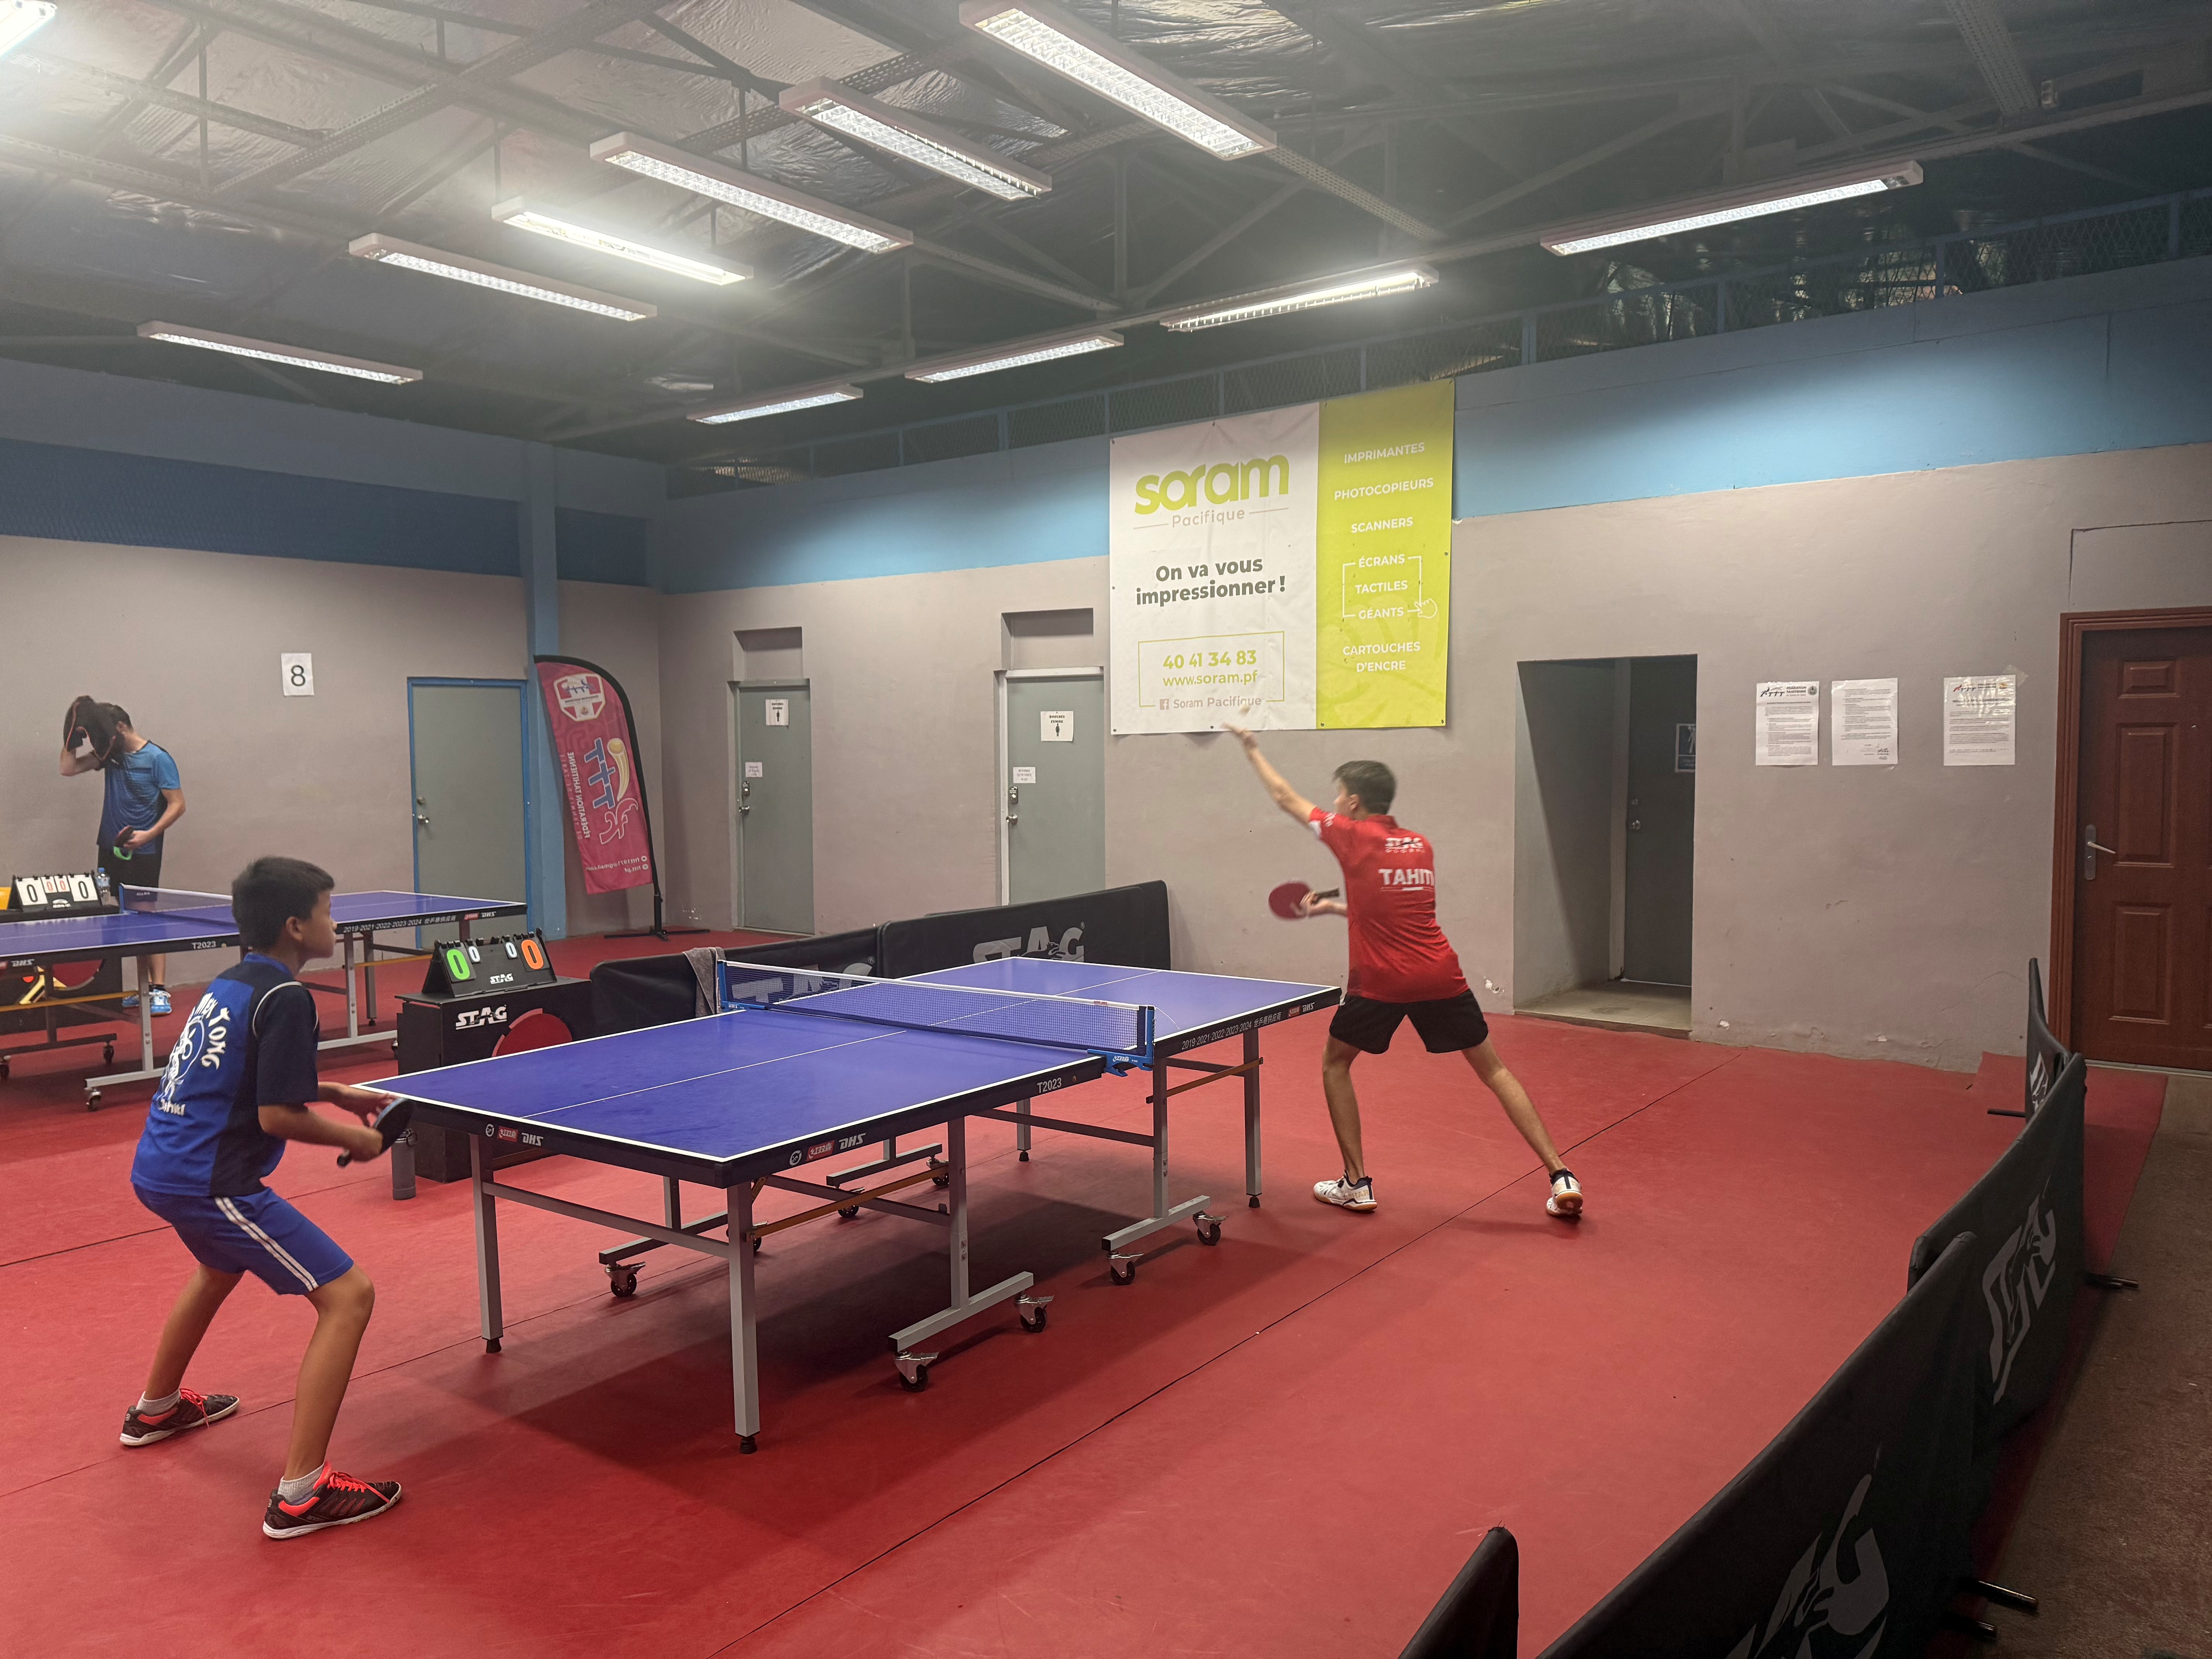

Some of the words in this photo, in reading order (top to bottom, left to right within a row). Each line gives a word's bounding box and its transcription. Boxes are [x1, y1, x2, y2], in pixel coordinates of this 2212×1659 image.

[1345, 442, 1424, 464] IMPRIMANTES
[1135, 455, 1290, 515] soram
[1334, 477, 1433, 500] PHOTOCOPIEURS
[1173, 510, 1245, 527] Pacifique
[1351, 517, 1413, 533] SCANNERS
[1359, 554, 1405, 568] ÉCRANS
[1156, 565, 1182, 581] On
[1188, 564, 1208, 578] va
[1215, 559, 1262, 575] vous
[1355, 580, 1408, 594] TACTILES
[1359, 607, 1404, 620] GÉANTS
[1343, 642, 1420, 655] CARTOUCHES
[1163, 654, 1184, 669] 40
[1189, 653, 1202, 667] 41
[1208, 651, 1231, 666] 34
[1236, 650, 1257, 665] 83
[1357, 661, 1406, 672] D'ENCRE
[291, 665, 306, 686] 8
[1163, 670, 1257, 686] www.soram.pf
[1173, 698, 1203, 709] Soram
[27, 884, 38, 902] 0
[47, 881, 53, 891] 0
[60, 880, 66, 890] 0
[78, 881, 89, 899] 0
[191, 941, 216, 950] T2023
[447, 949, 470, 980] 0
[468, 946, 480, 962] 0
[505, 942, 517, 958] 0
[521, 939, 544, 969] 0
[490, 974, 514, 984] STAG
[1302, 1002, 1315, 1012] DHS
[456, 1006, 507, 1030] STAG
[1037, 1077, 1062, 1093] T2023
[521, 1133, 544, 1146] DHS
[839, 1133, 866, 1149] DHS
